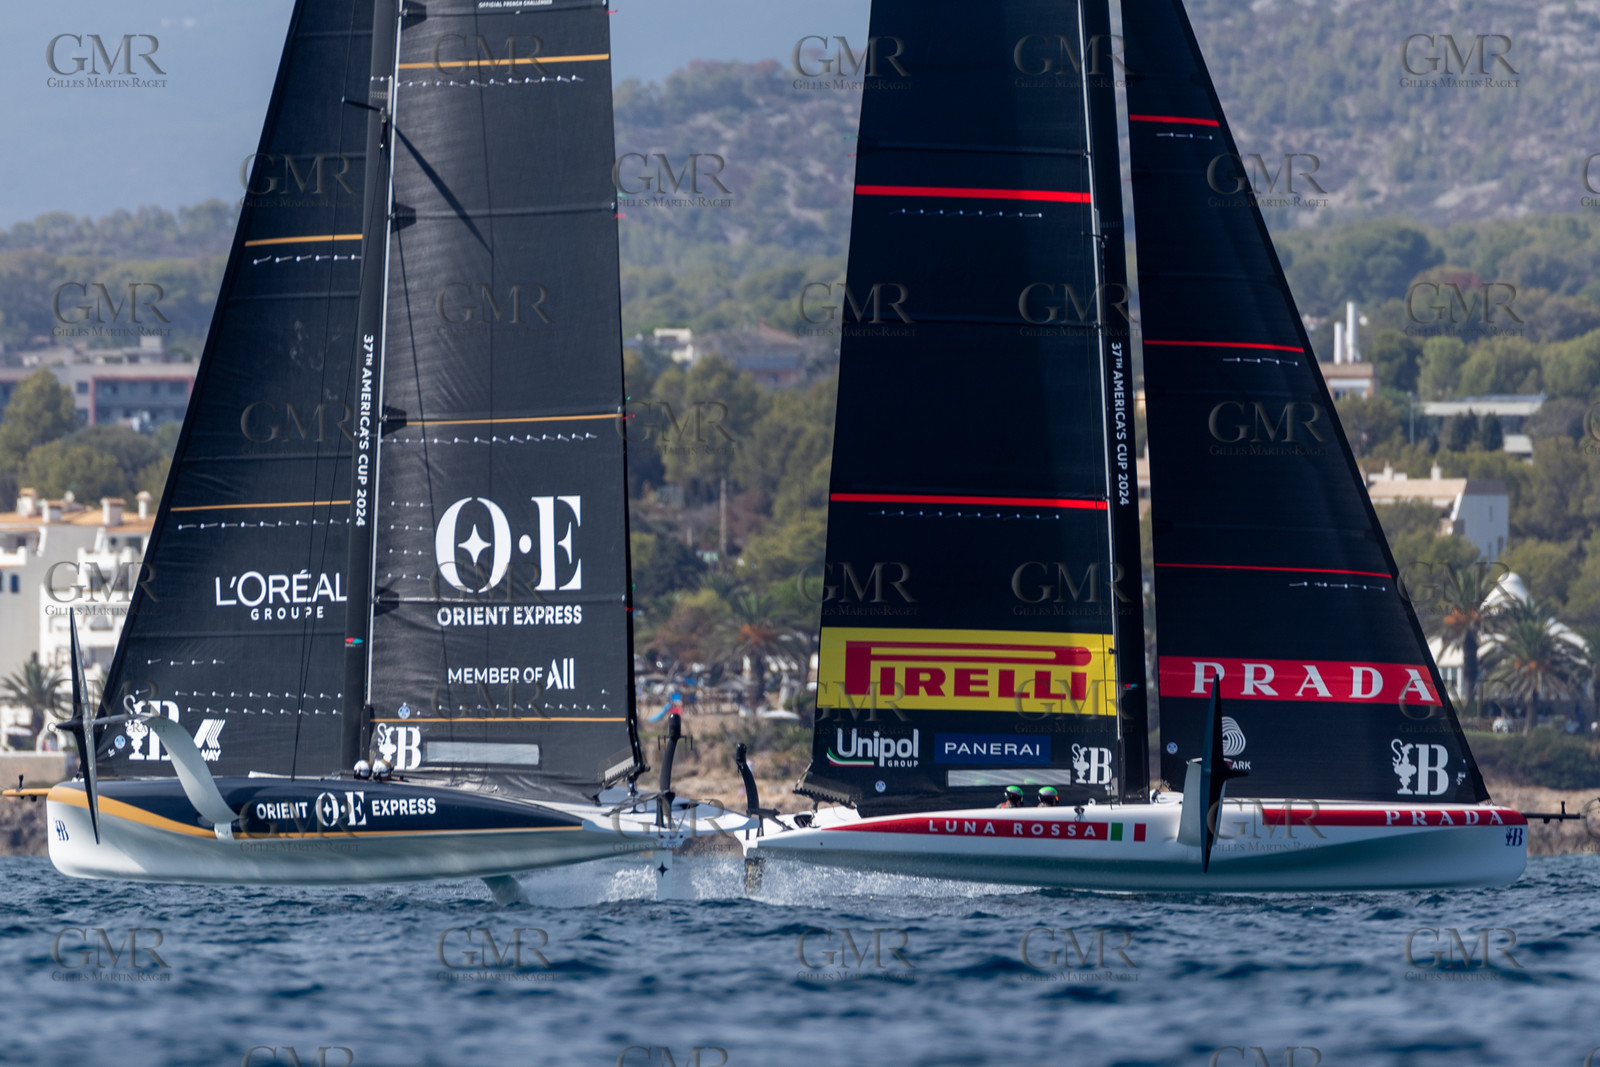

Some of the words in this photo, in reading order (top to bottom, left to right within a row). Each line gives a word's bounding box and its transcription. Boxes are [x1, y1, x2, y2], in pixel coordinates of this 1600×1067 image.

[359, 367, 372, 450] AMERICA'S
[1113, 370, 1127, 440] AMERICA'S
[358, 454, 369, 485] CUP
[1116, 444, 1128, 470] CUP
[1118, 474, 1130, 506] 2024
[356, 488, 367, 527] 2024
[215, 569, 348, 607] L'ORÉAL
[250, 606, 324, 621] GROUPE
[436, 606, 510, 626] ORIENT
[513, 605, 582, 625] EXPRESS
[448, 666, 520, 684] MEMBER
[523, 666, 543, 684] OF
[845, 640, 1092, 701] PIRELLI
[1191, 661, 1435, 702] PRADA
[836, 728, 919, 767] Unipol
[944, 742, 1040, 756] PANERAI
[888, 760, 919, 768] GROUP
[256, 802, 308, 820] ORIENT
[371, 797, 437, 816] EXPRESS
[1384, 810, 1504, 825] PRADA
[929, 820, 996, 835] LUNA
[1013, 822, 1096, 838] ROSSA
